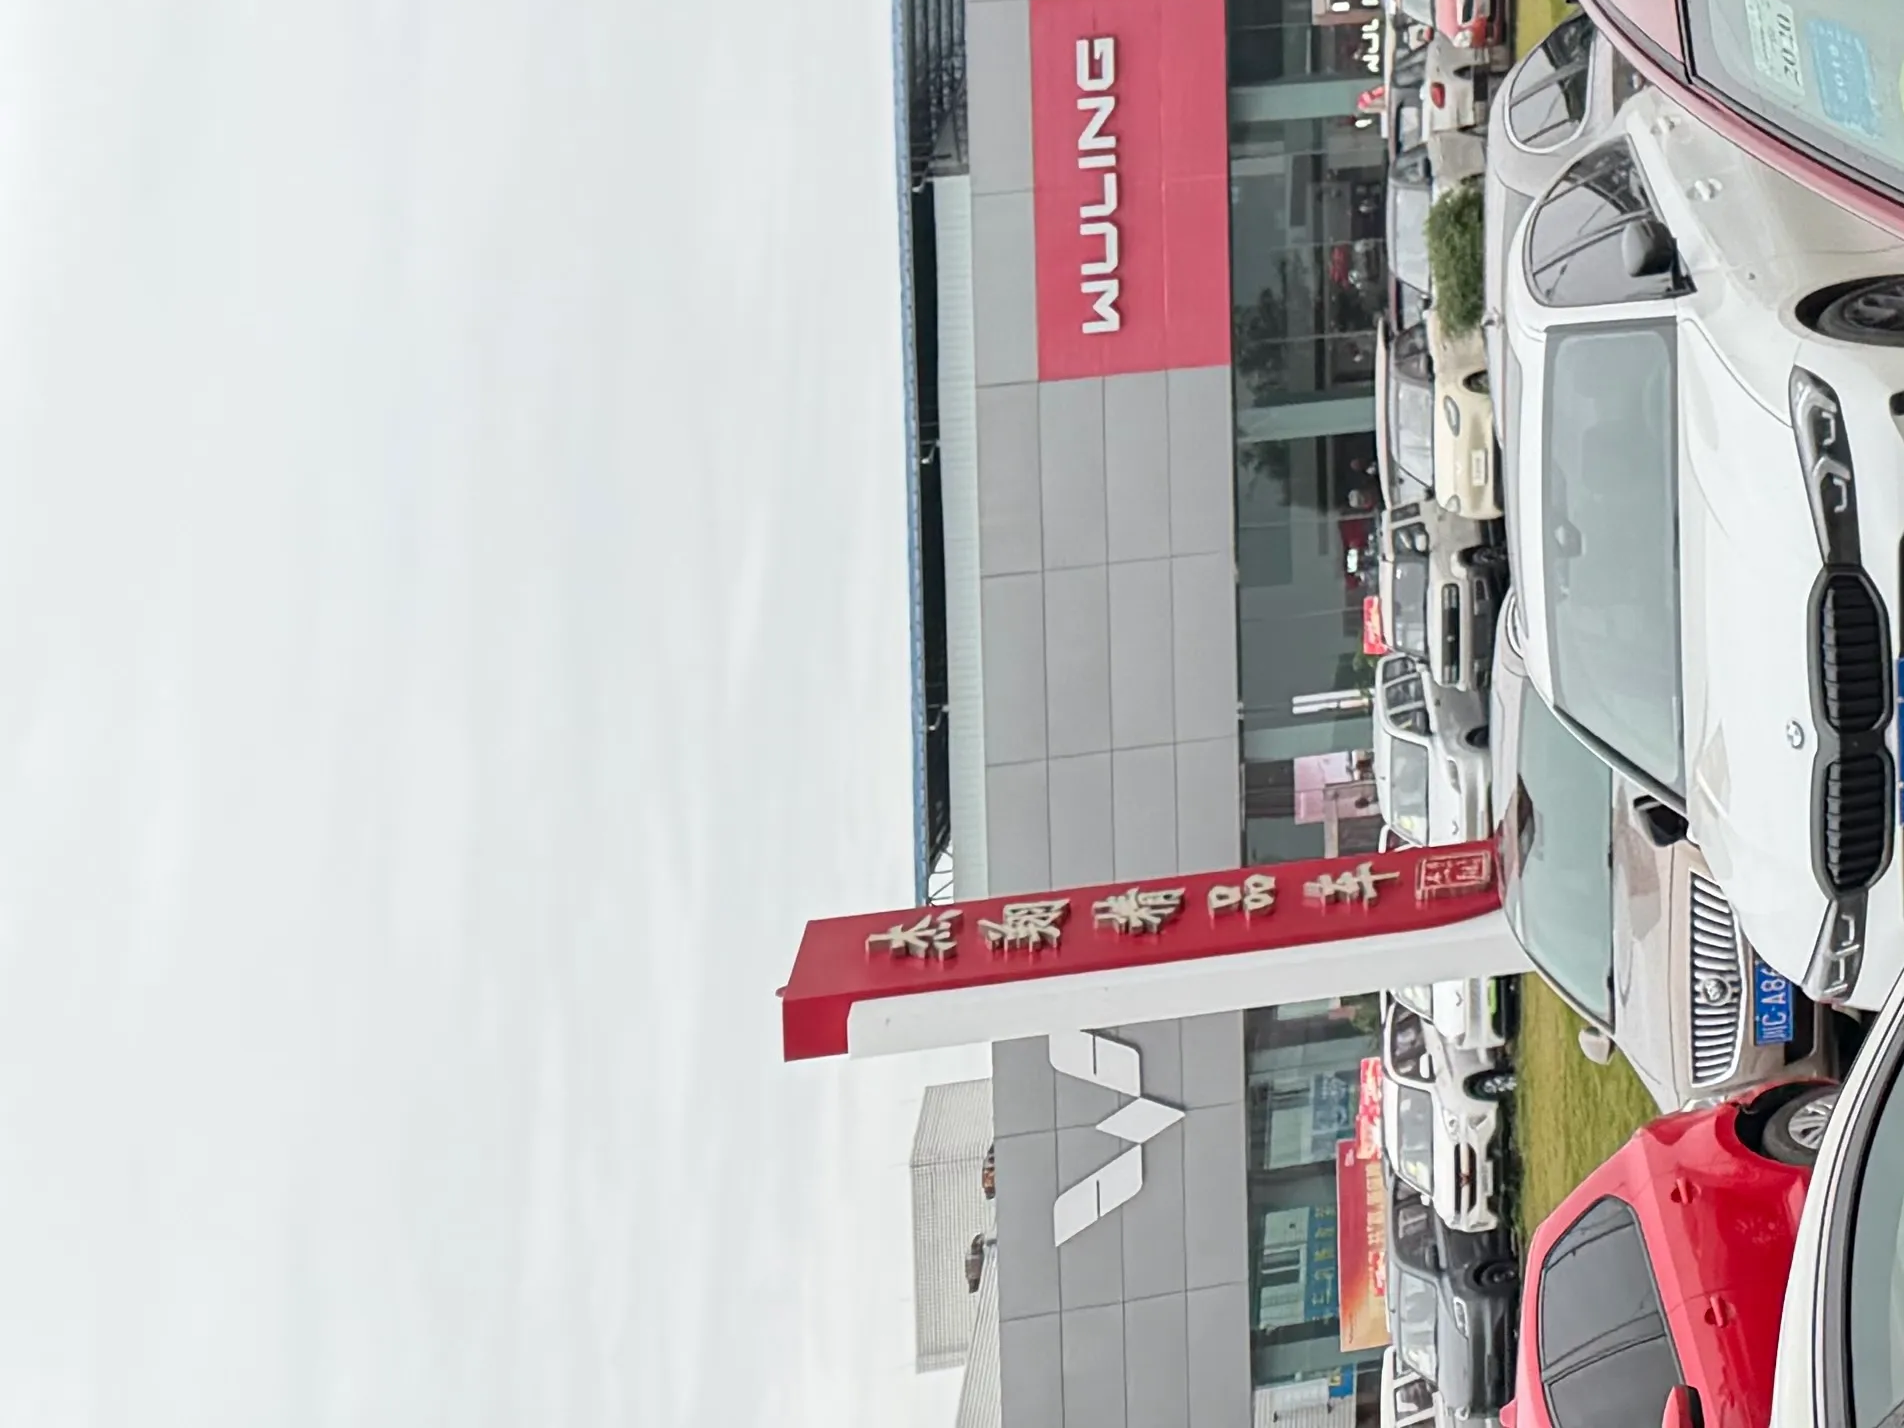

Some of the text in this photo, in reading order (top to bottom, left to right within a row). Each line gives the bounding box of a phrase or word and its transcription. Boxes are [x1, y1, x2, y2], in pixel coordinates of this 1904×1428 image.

[1075, 36, 1121, 334] WULING
[864, 862, 1400, 958] 杰翔精品车
